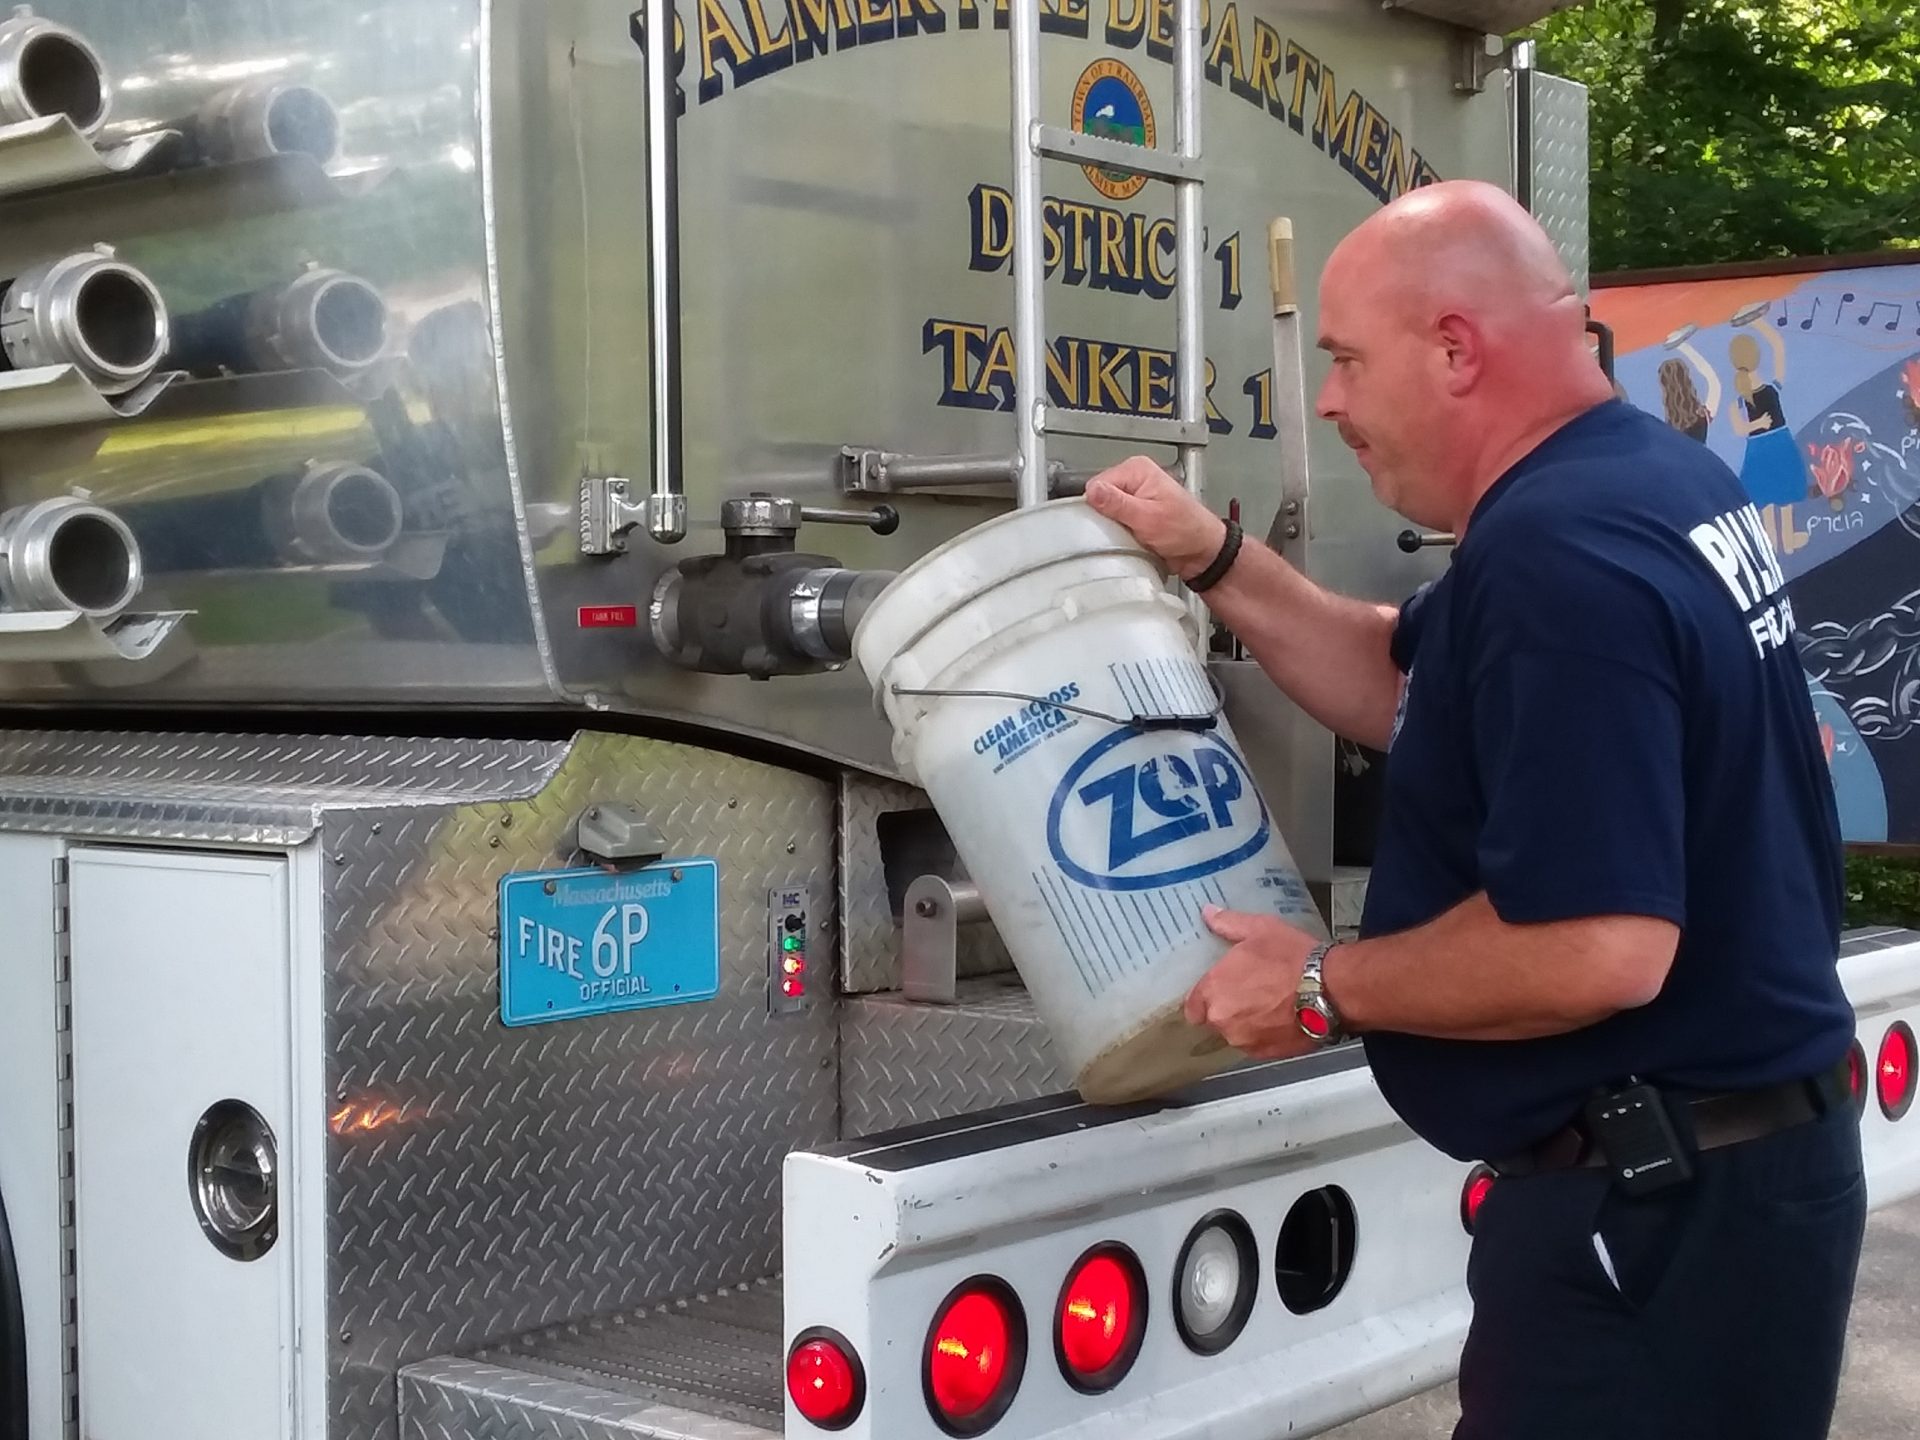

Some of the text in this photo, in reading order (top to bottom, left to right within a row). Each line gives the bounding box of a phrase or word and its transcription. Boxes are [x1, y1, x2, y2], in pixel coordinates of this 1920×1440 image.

[629, 0, 1443, 206] ALM DEARTMEN
[968, 183, 1243, 310] DSTRIC 1
[1243, 368, 1278, 440] 1
[973, 681, 1081, 756] CLEAN ACROSS
[997, 708, 1068, 760] AMERICA
[552, 880, 673, 908] Massachusetts
[518, 903, 650, 981] FIRE 6P
[580, 975, 652, 1001] OFFICIAL
